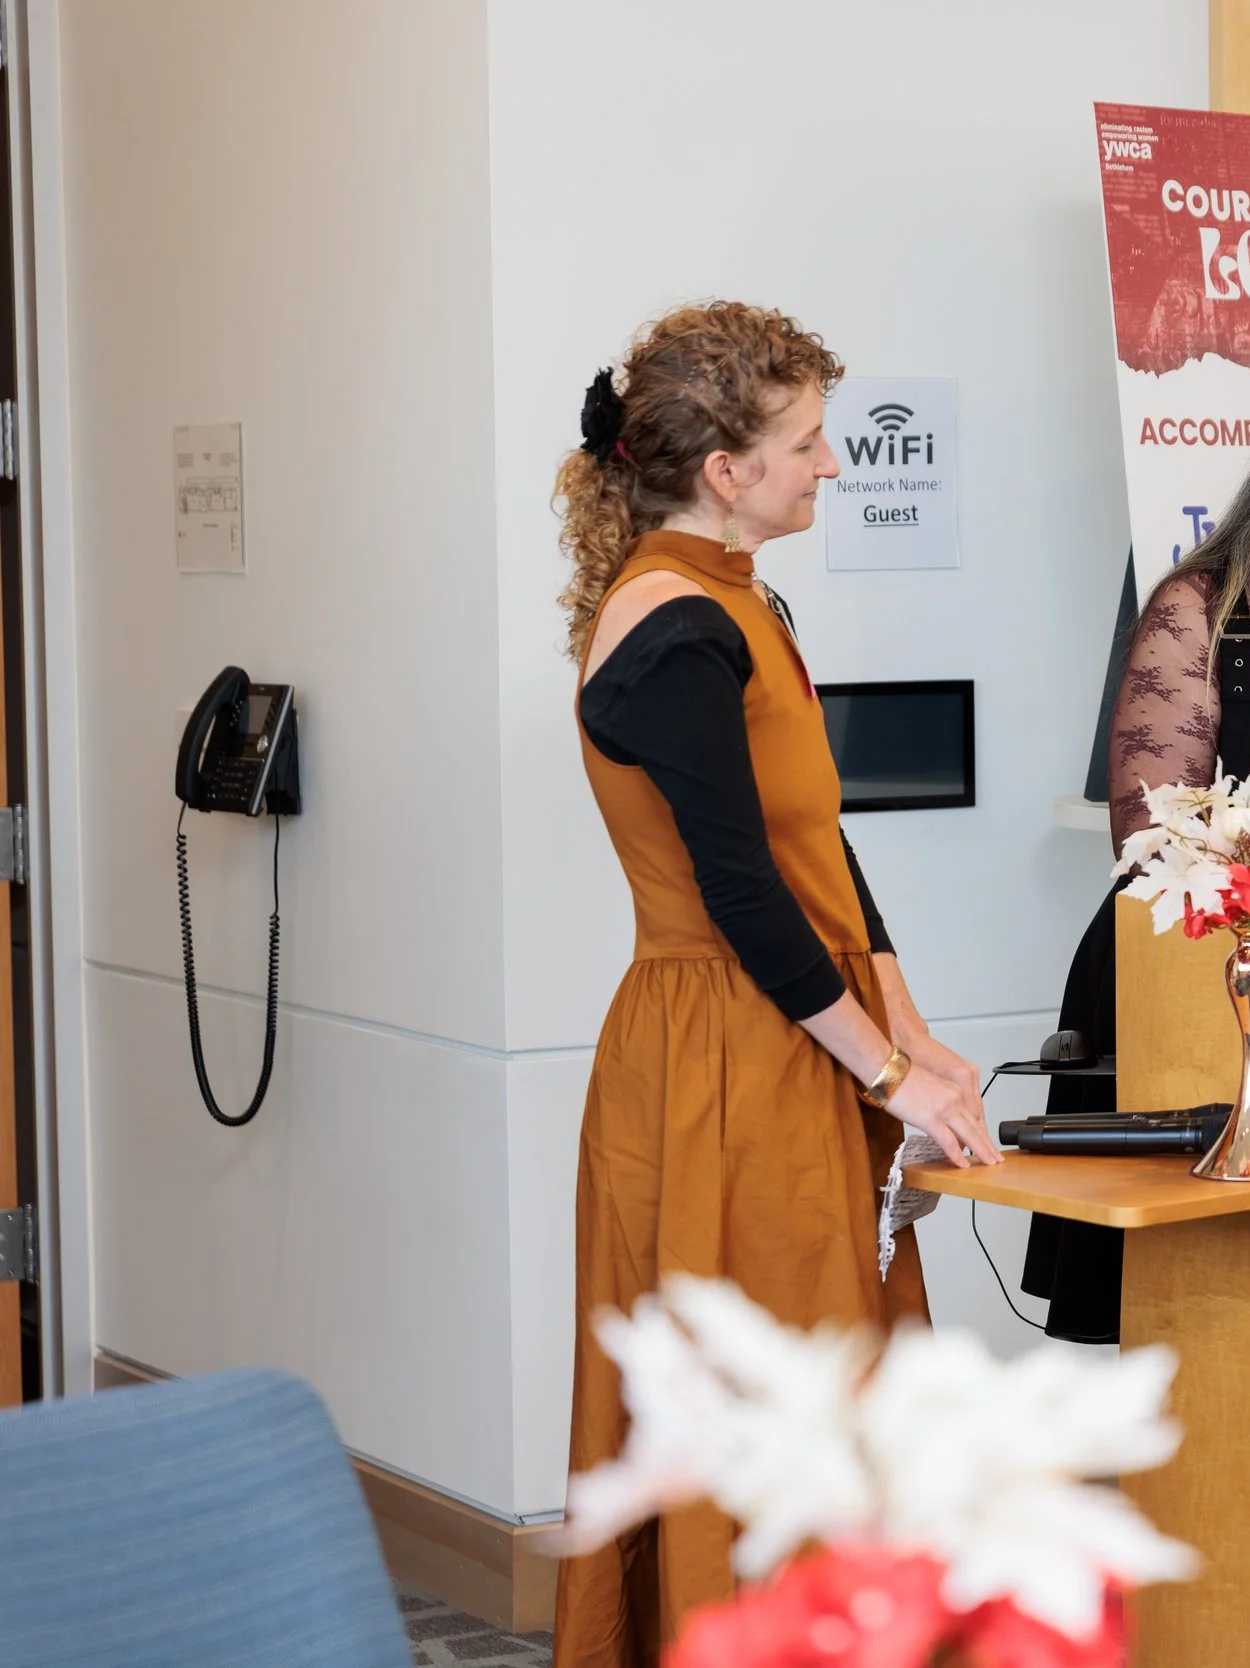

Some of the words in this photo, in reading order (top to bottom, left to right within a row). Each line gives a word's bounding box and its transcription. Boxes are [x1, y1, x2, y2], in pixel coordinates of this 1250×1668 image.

[1101, 123, 1132, 133] eliminating
[1133, 125, 1153, 134] racism
[1102, 132, 1137, 141] empowering
[1103, 140, 1152, 161] ywca
[1105, 163, 1134, 172] Bethlehem
[845, 433, 934, 466] WiFi
[837, 478, 895, 493] Network
[899, 478, 942, 492] Name:
[863, 504, 919, 523] Guest
